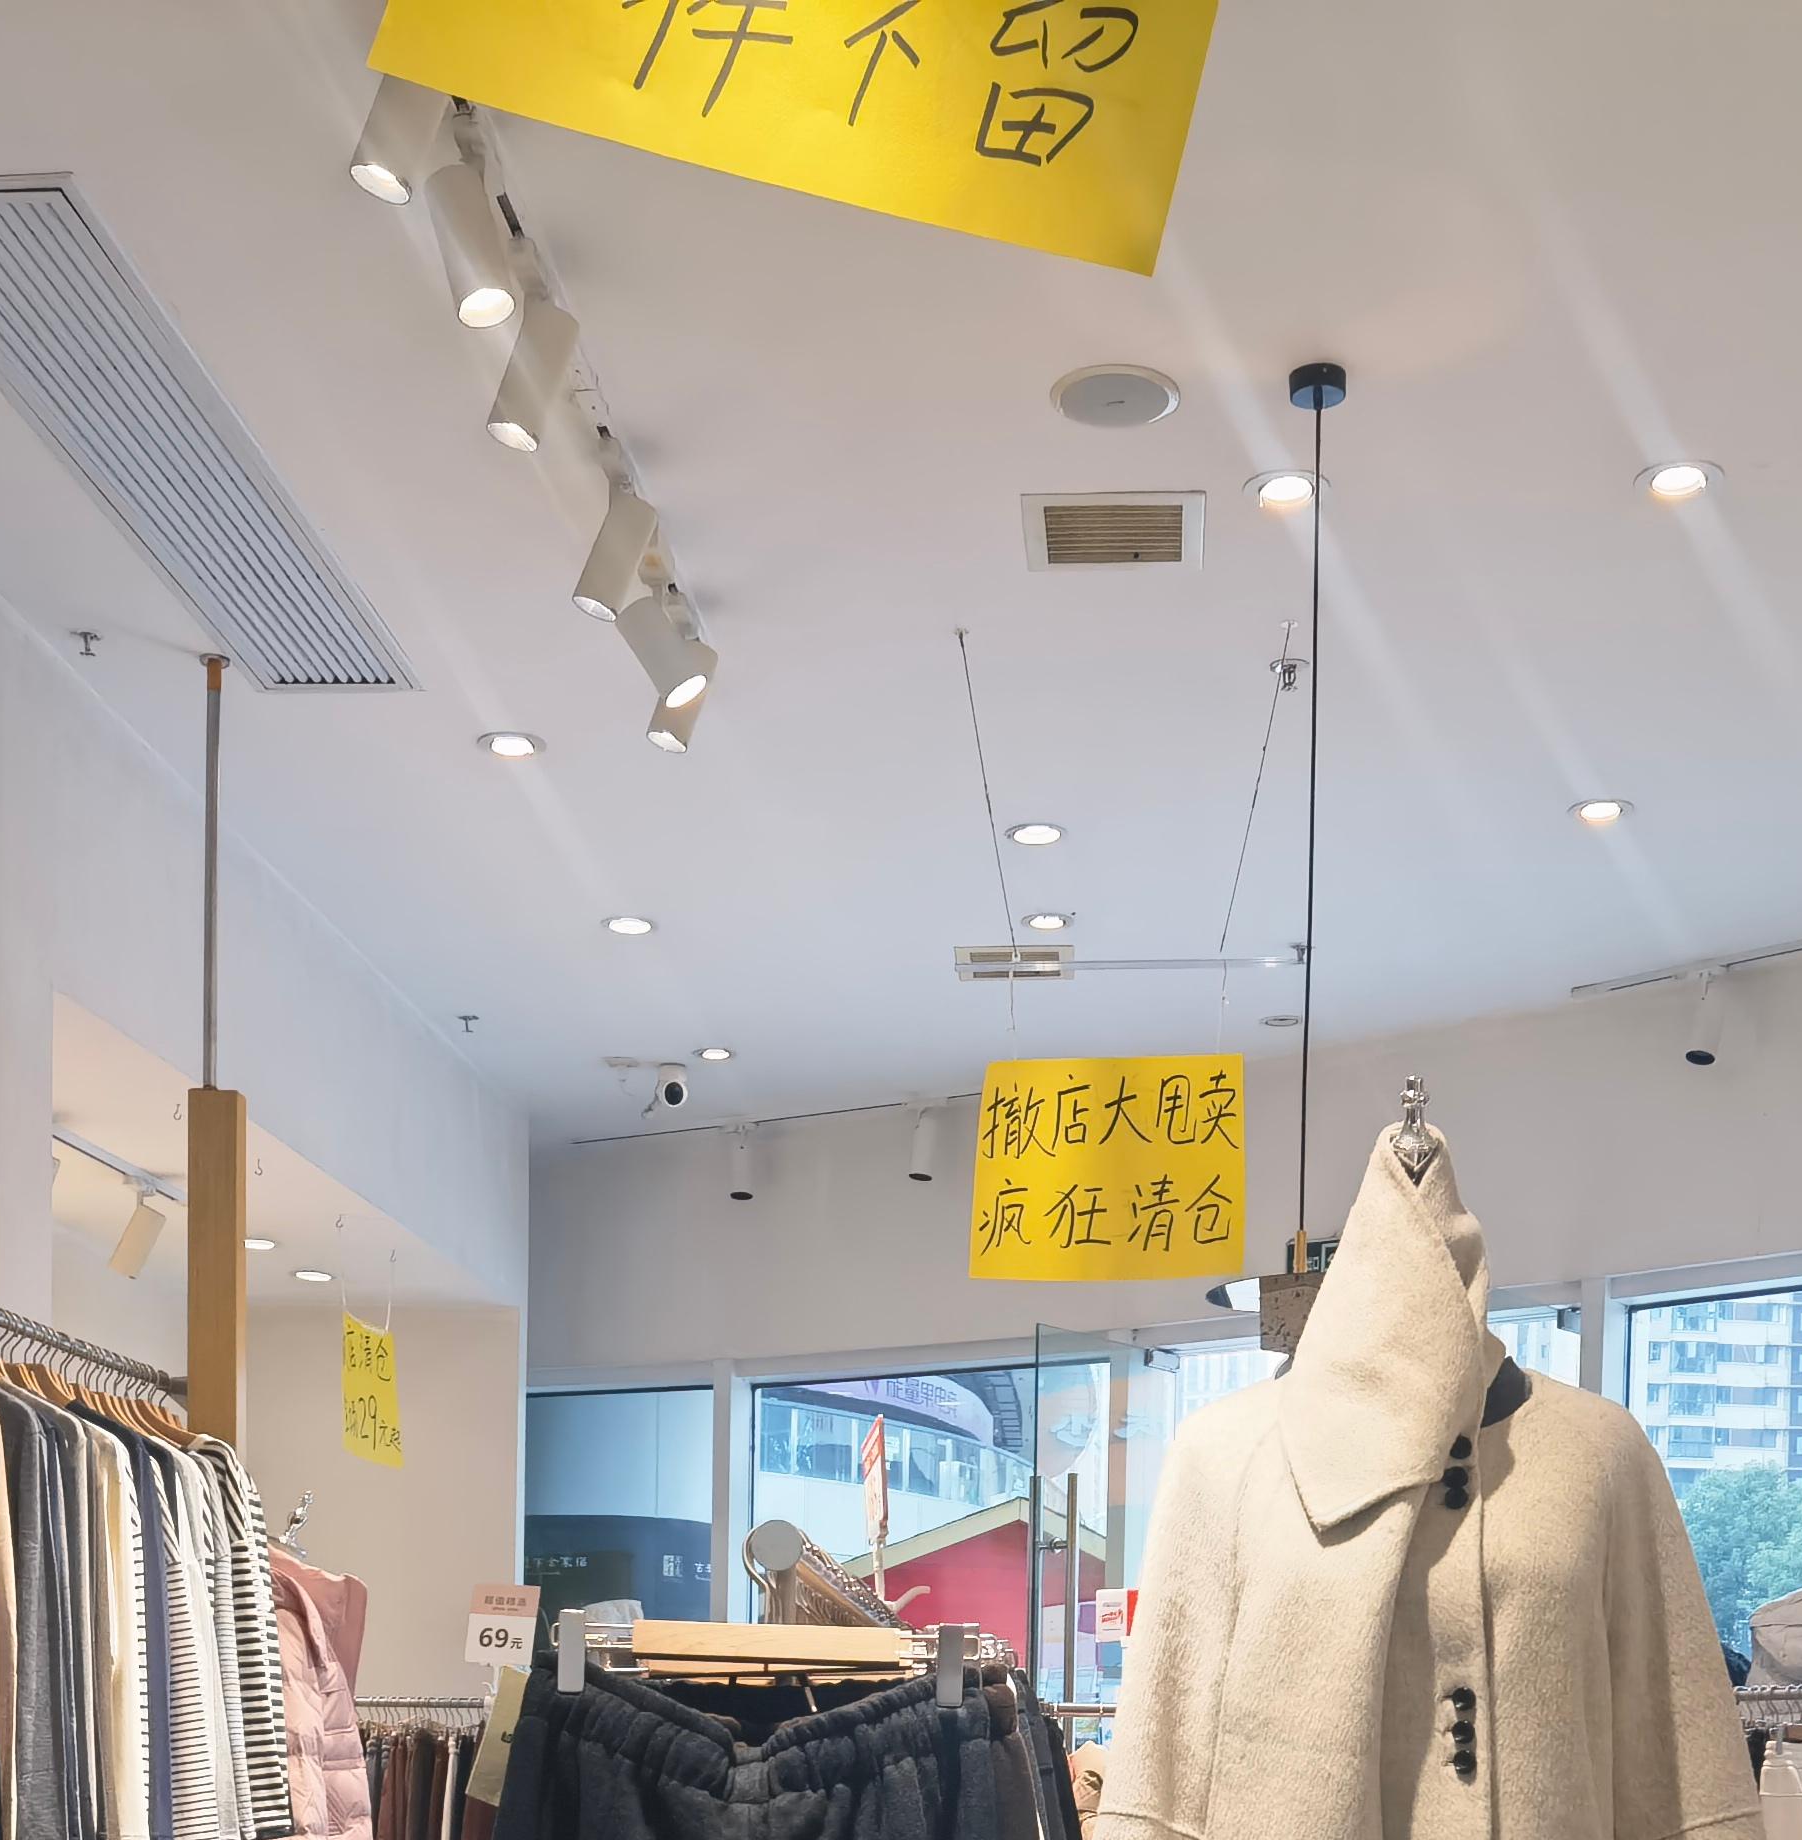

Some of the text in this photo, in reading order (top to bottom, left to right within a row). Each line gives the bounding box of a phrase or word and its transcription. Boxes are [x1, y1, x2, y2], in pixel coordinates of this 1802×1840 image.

[981, 1070, 1240, 1161] 撤店大甩卖
[978, 1173, 1233, 1257] 疯狂清仓
[478, 1626, 524, 1650] 69元
